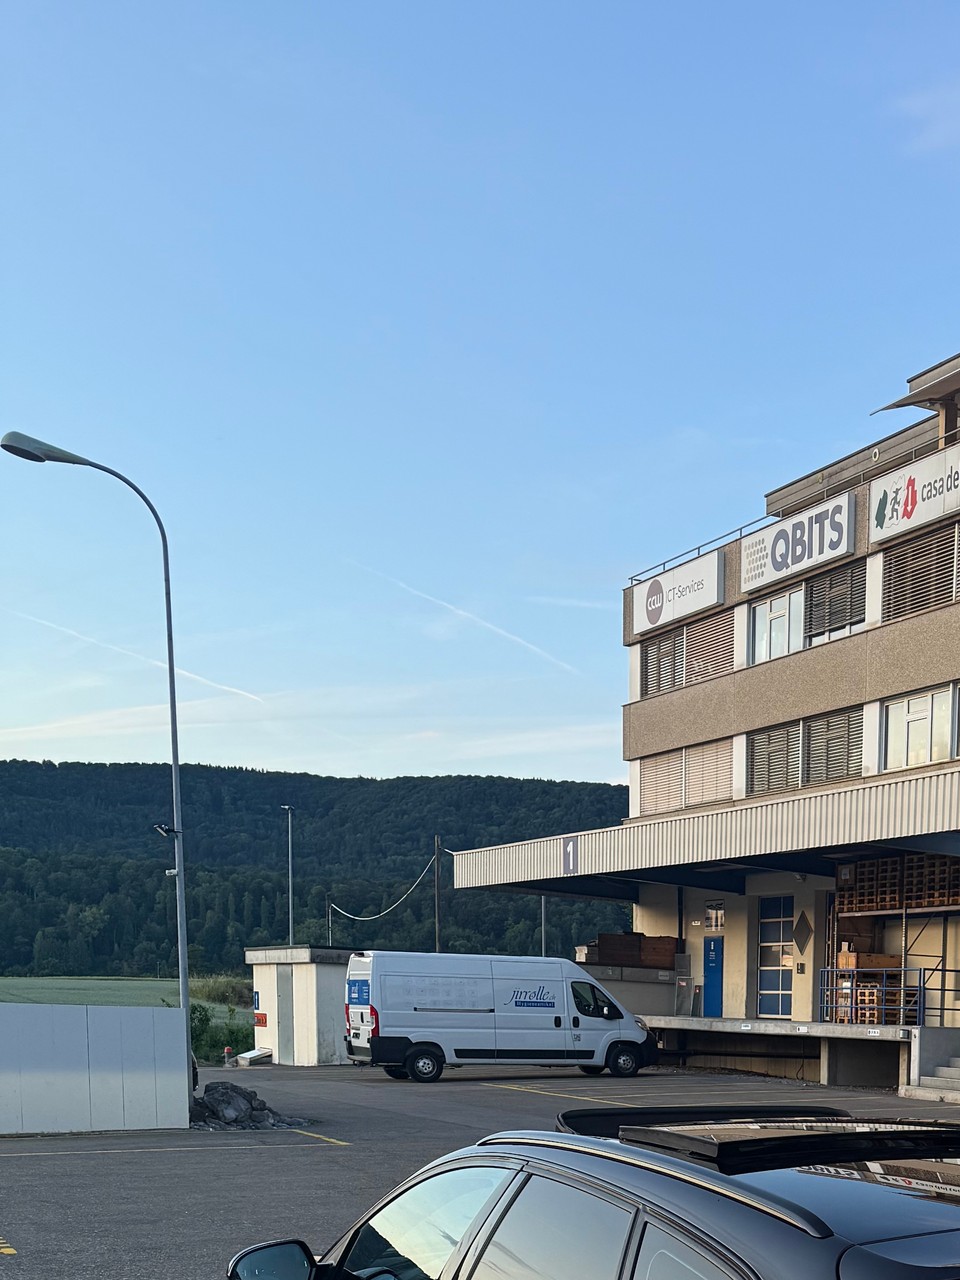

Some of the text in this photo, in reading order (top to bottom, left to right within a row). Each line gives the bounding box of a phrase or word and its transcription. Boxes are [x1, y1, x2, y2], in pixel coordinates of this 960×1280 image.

[770, 504, 844, 572] QBITS
[665, 578, 705, 604] ICT-Services
[566, 841, 574, 870] 1
